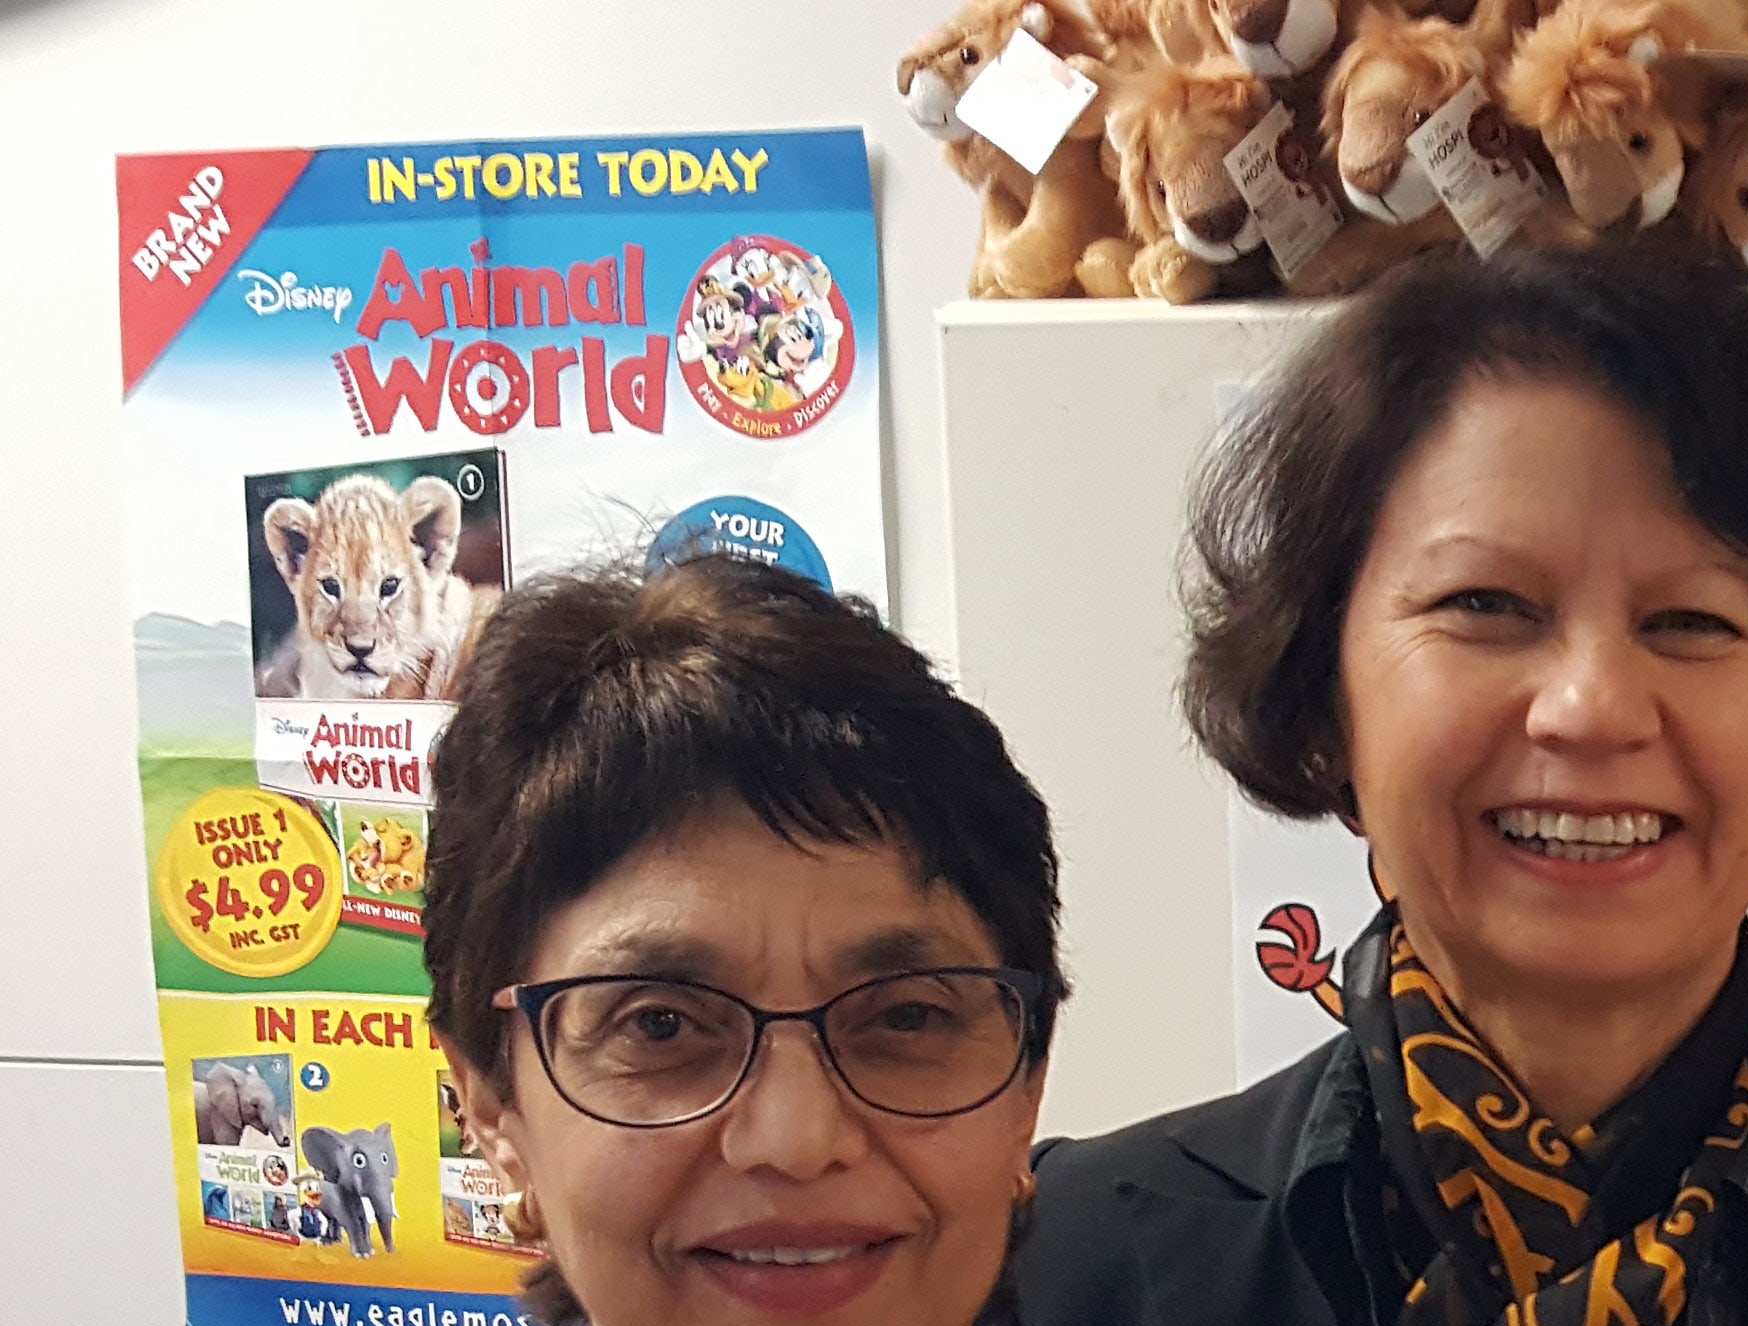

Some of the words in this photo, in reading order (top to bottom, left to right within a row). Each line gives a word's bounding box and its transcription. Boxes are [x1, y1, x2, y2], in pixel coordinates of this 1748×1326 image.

[367, 152, 583, 203] IN-STORE
[597, 148, 769, 197] TODAY
[132, 166, 225, 282] BRAND
[169, 204, 232, 287] NEW
[356, 236, 647, 340] Animal
[343, 334, 670, 436] World
[710, 509, 785, 546] YOUR
[311, 712, 412, 751] Animal
[304, 750, 421, 795] World
[194, 813, 265, 845] ISSUE
[273, 807, 288, 833] 1
[211, 838, 283, 869] ONLY
[186, 863, 325, 933] $4.99
[229, 931, 265, 950] INC.
[269, 924, 301, 943] GST
[255, 1006, 296, 1042] IN
[312, 1009, 413, 1048] EACH
[308, 1064, 324, 1087] 2
